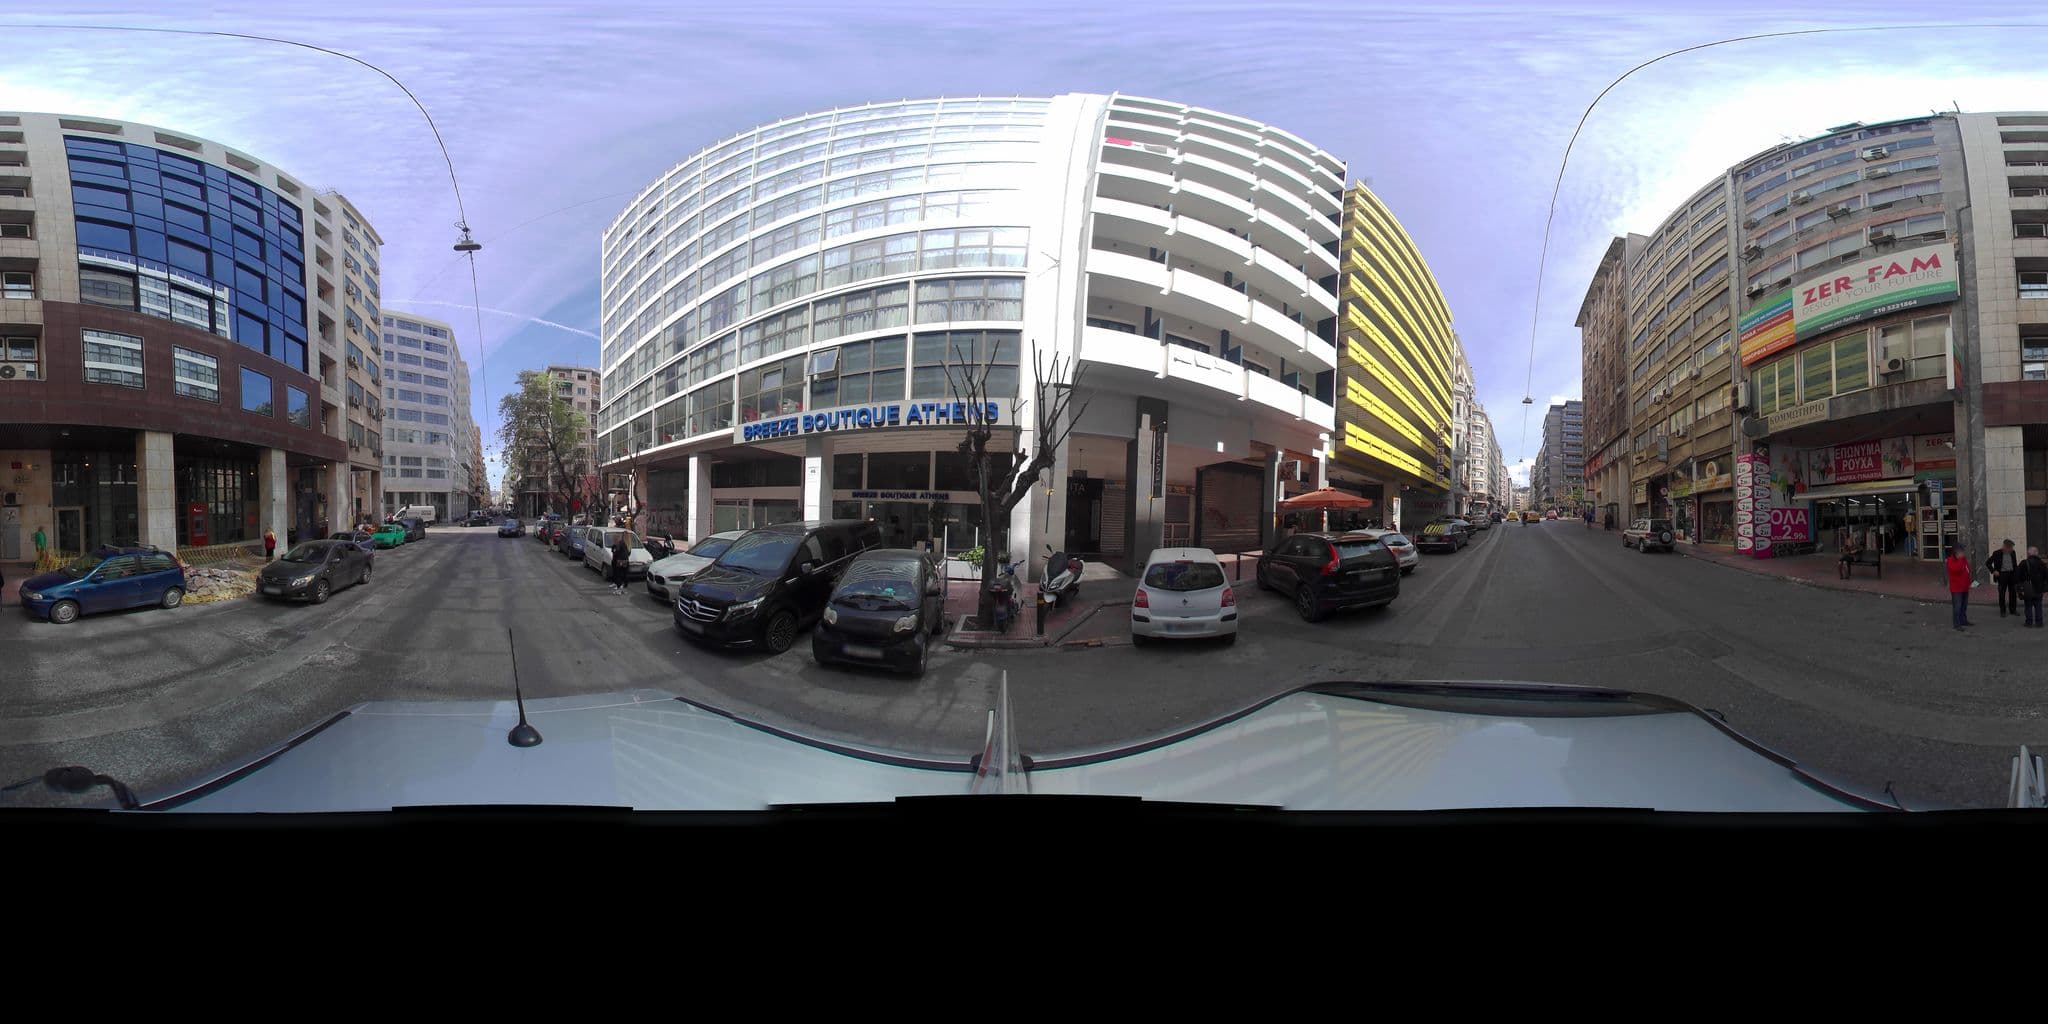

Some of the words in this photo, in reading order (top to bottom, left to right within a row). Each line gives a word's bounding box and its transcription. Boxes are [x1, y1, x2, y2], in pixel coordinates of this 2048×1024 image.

[1802, 296, 1840, 315] DESIGN
[1845, 282, 1881, 300] YOUR
[1888, 269, 1943, 287] FUTURE
[743, 416, 799, 442] BREEZE
[802, 404, 900, 433] BOUTIQUE
[907, 402, 999, 424] ATHENS
[1835, 442, 1882, 460] ΕΠΩΝΥΜΑ
[1842, 456, 1875, 471] ΡΟΥΧΑ
[919, 492, 949, 500] ATHENS
[1771, 509, 1807, 525] ΟΛΑ
